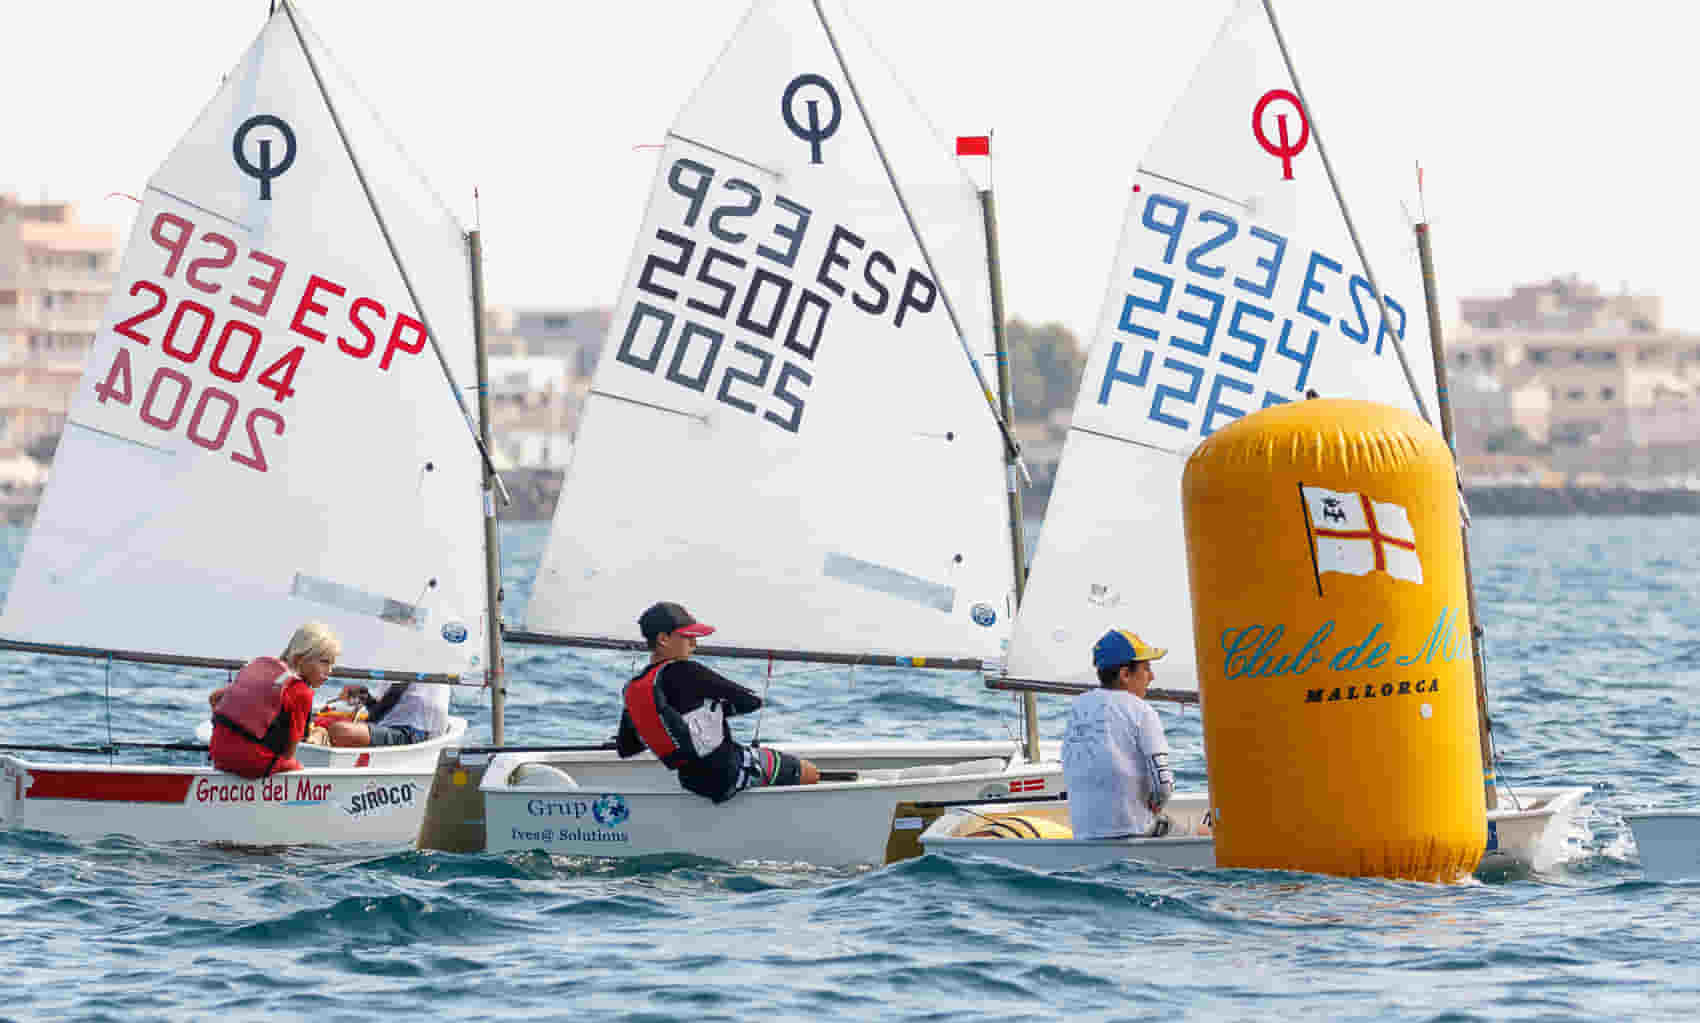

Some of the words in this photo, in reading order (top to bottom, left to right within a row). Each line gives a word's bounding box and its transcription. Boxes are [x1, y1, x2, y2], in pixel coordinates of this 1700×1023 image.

[638, 229, 831, 360] 2500
[816, 224, 937, 328] ESP
[1297, 251, 1406, 355] ESP
[113, 280, 304, 402] 2004
[289, 275, 428, 371] ESP
[1117, 267, 1319, 391] 2354
[1220, 620, 1334, 680] Club
[1329, 623, 1390, 671] de
[1304, 679, 1439, 702] MALLORCA
[196, 776, 254, 803] Gracia
[262, 775, 289, 801] del
[296, 775, 331, 801] Mar
[348, 782, 414, 814] SIROCO
[527, 799, 587, 819] Grup
[559, 827, 629, 843] Solutions
